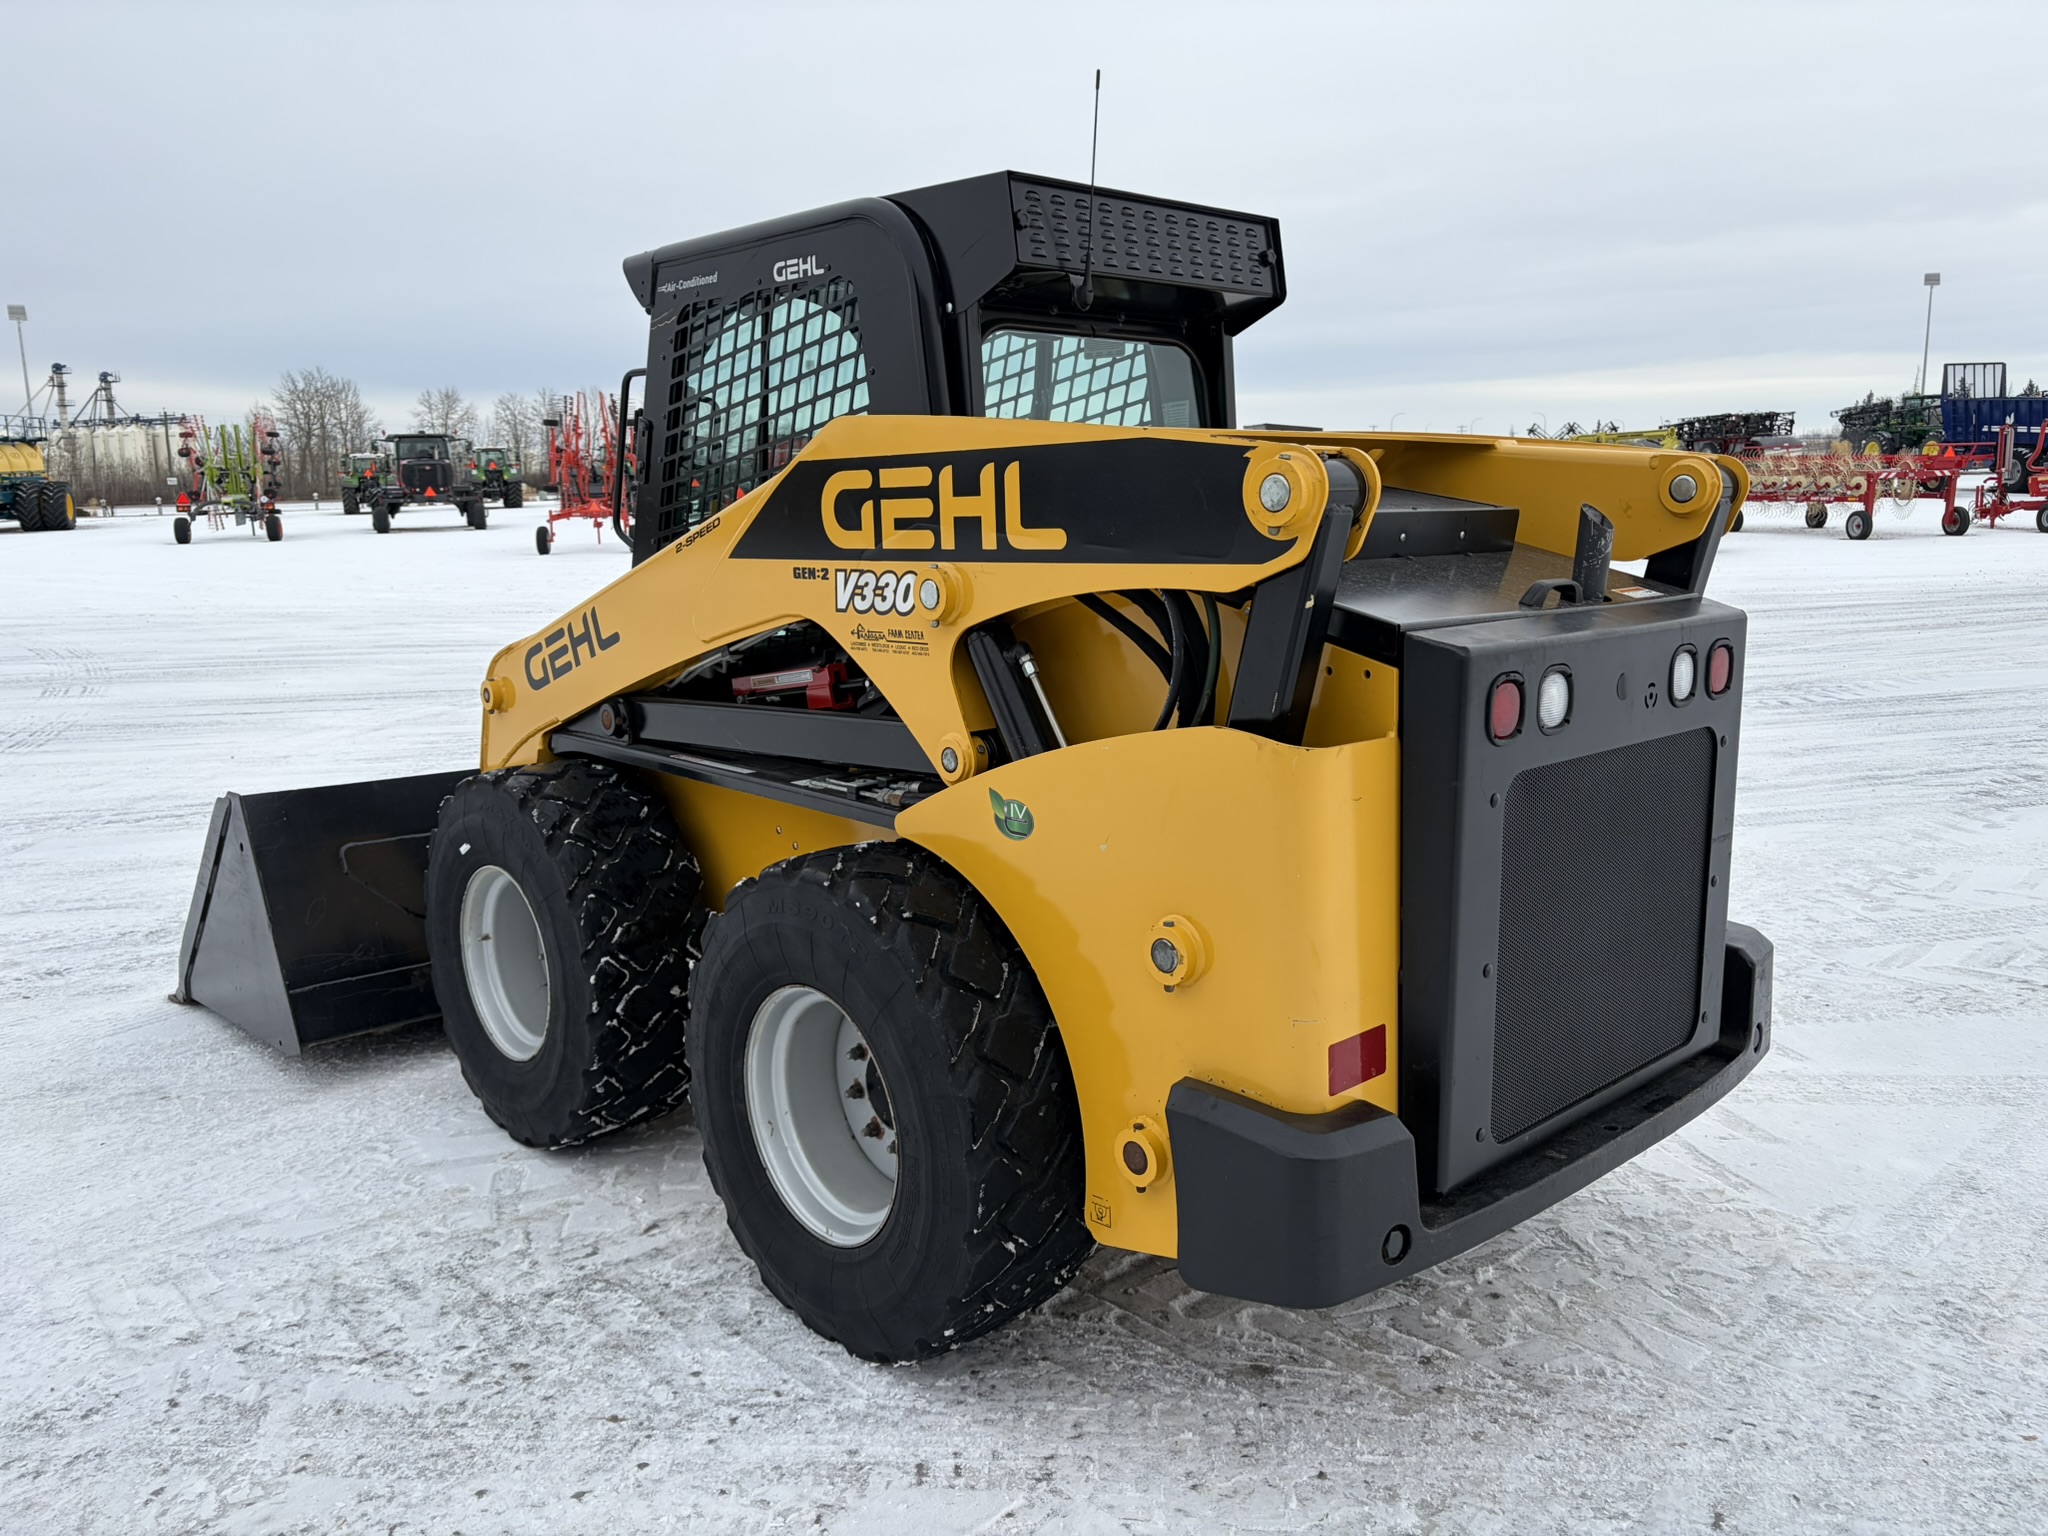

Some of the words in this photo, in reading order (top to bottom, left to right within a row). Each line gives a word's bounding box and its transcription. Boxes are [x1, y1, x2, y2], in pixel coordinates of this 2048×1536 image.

[666, 271, 718, 293] Air-Conditioned
[773, 255, 825, 282] GEHL
[821, 460, 1068, 550] GEHL
[675, 517, 721, 554] 2-SPEED
[793, 566, 830, 580] GEN:2
[835, 568, 918, 617] V330
[524, 606, 621, 691] GEHL
